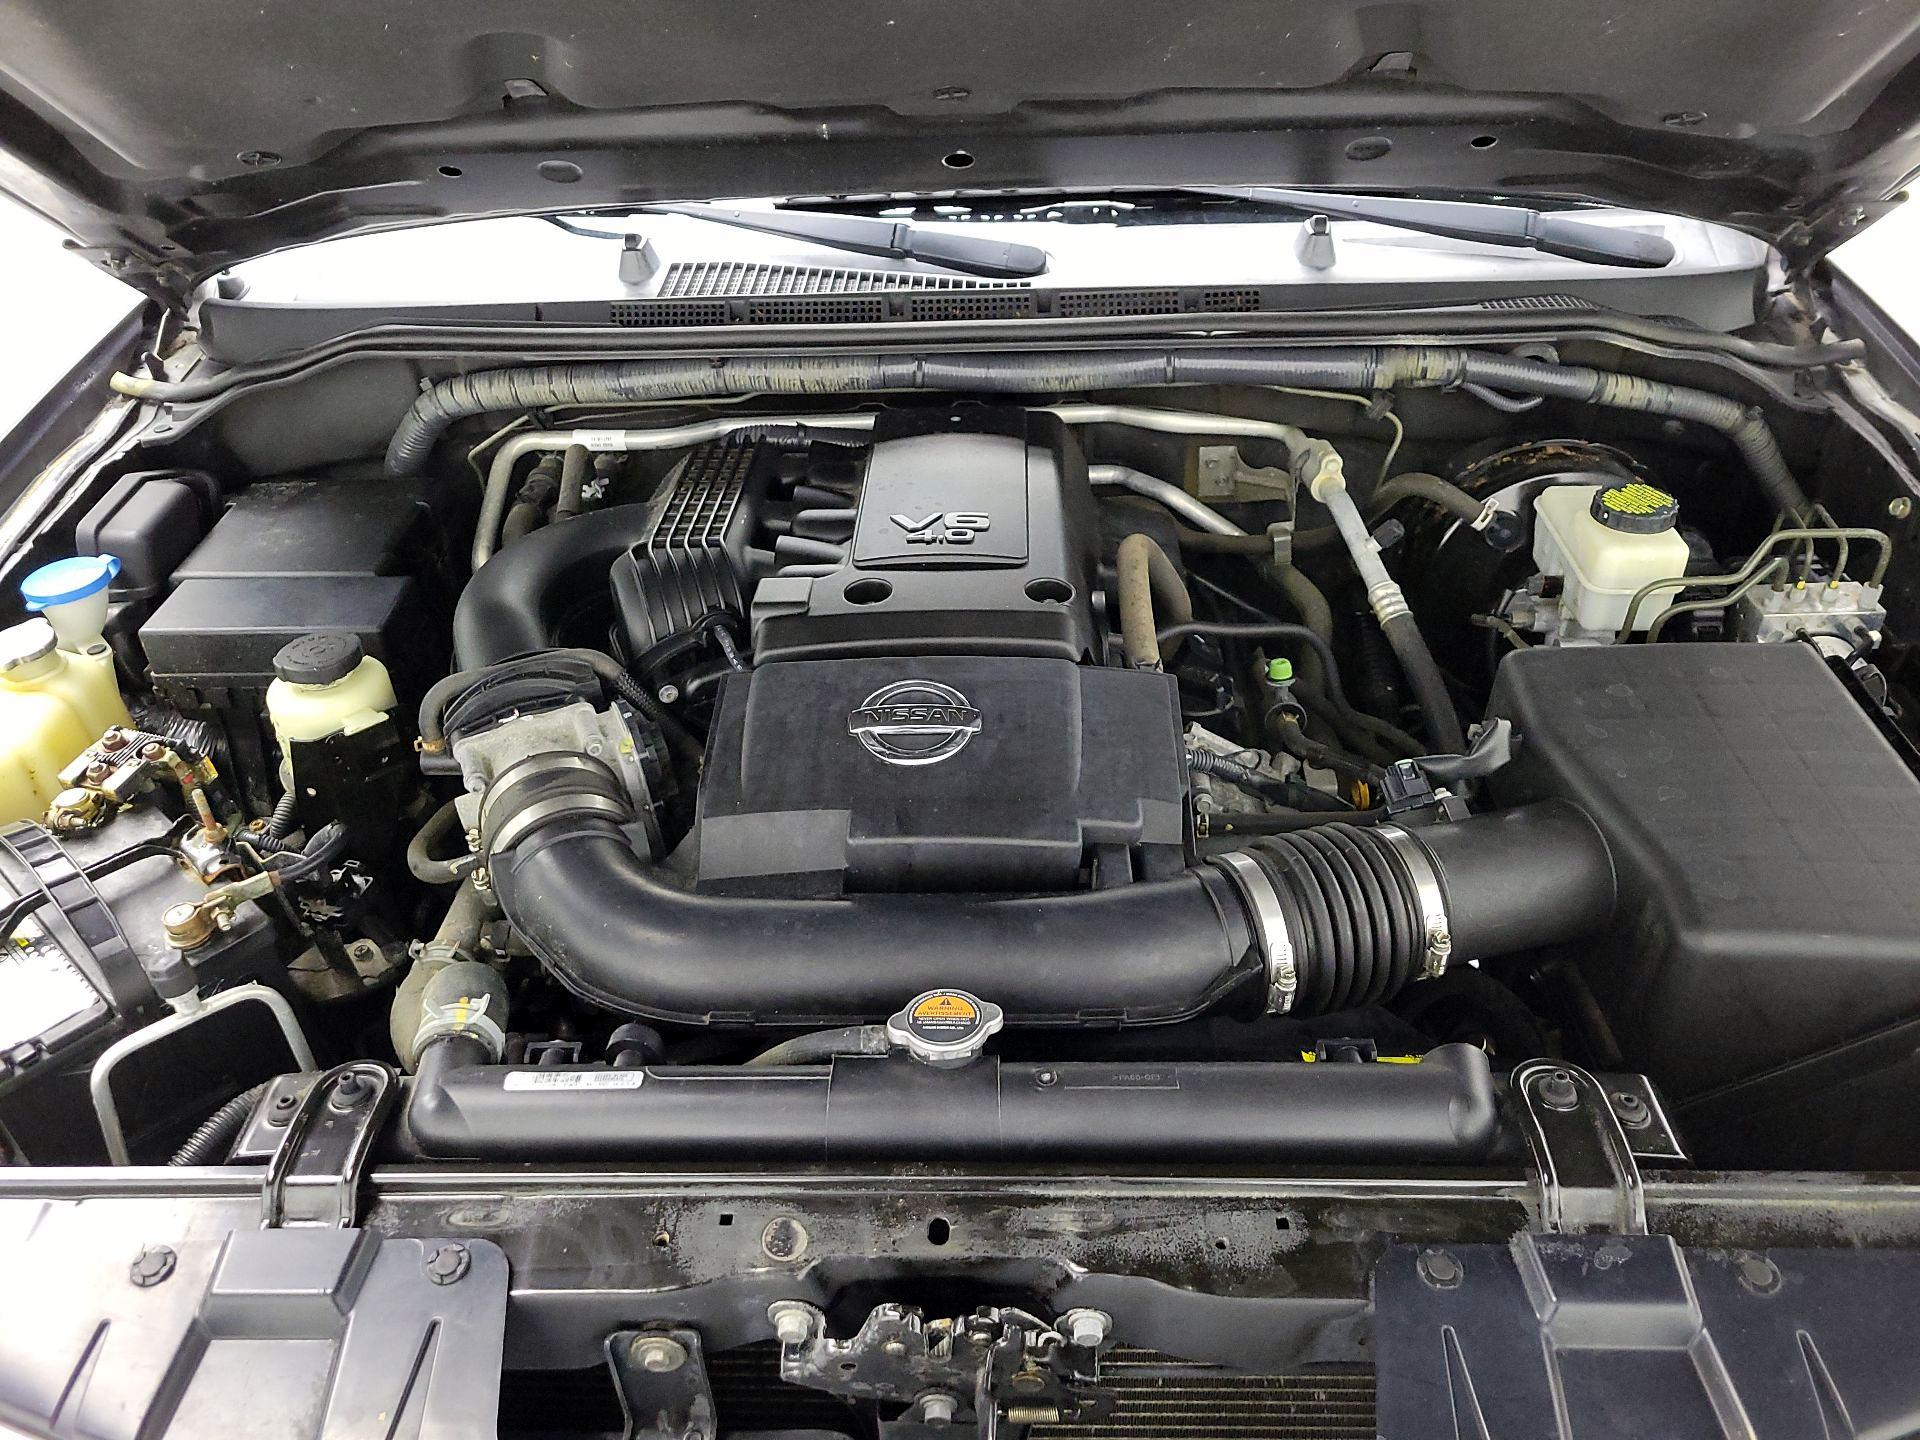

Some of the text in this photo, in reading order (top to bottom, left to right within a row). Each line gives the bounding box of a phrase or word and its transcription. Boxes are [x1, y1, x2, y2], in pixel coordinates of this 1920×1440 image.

[889, 511, 991, 533] V6
[905, 529, 976, 545] 4.0
[863, 707, 967, 722] NISSAN
